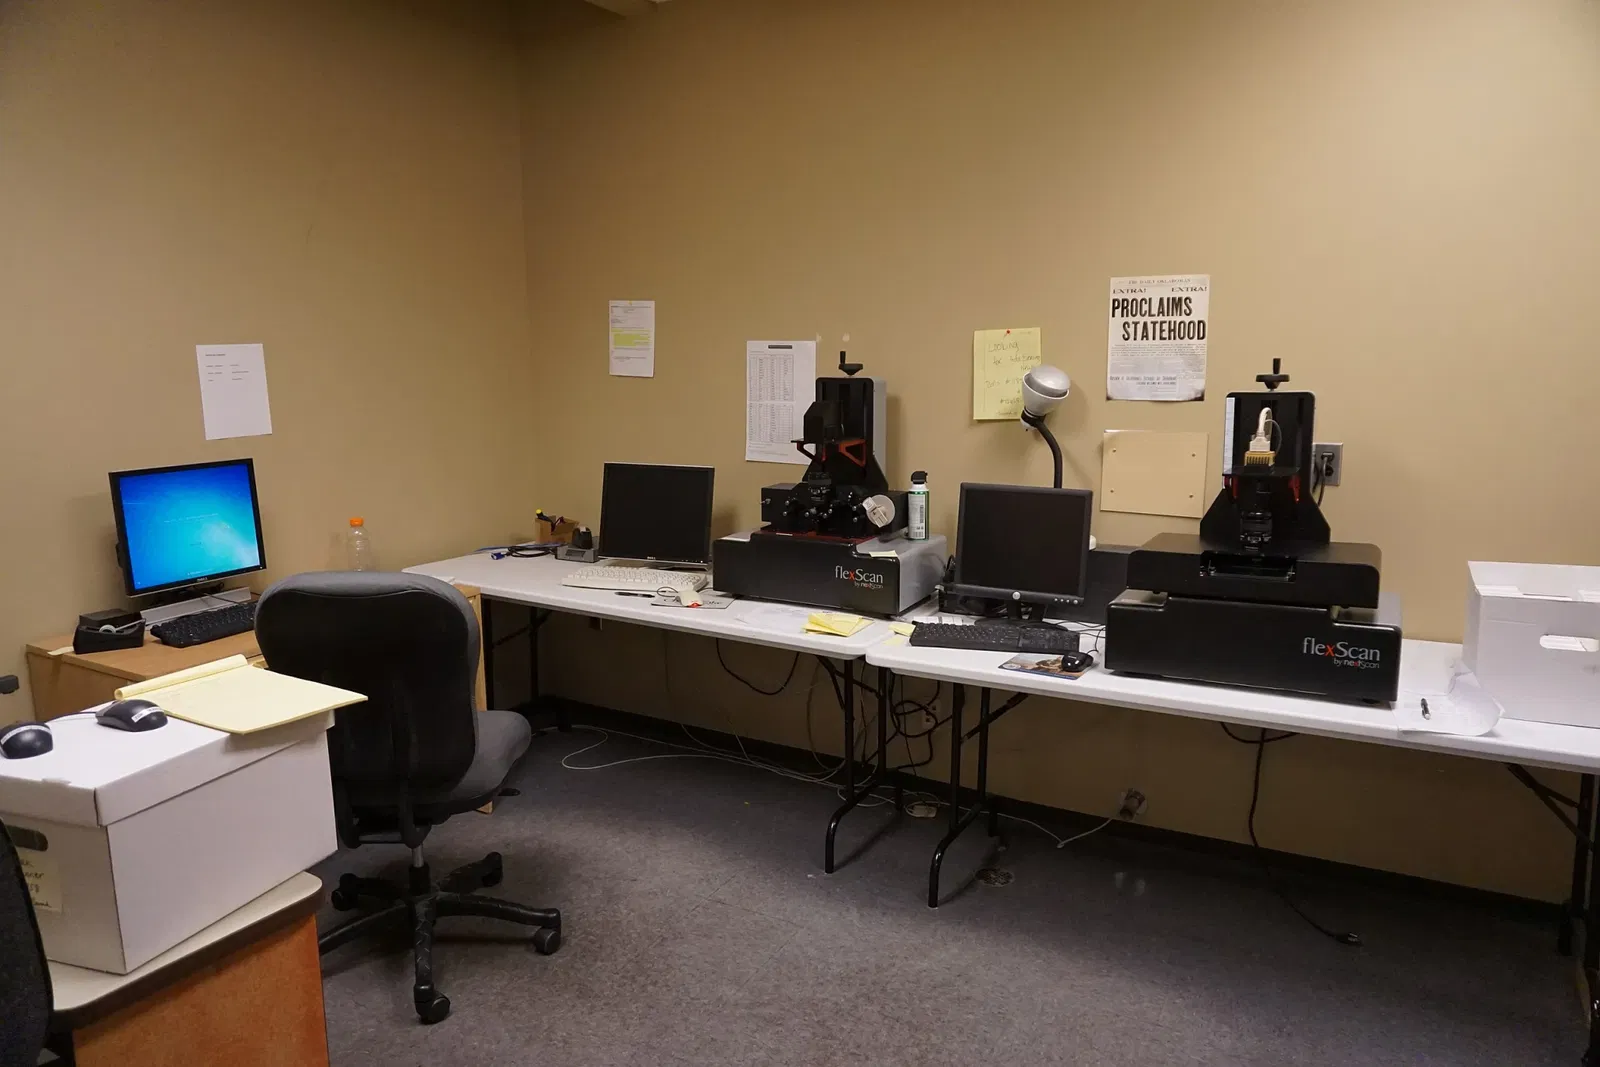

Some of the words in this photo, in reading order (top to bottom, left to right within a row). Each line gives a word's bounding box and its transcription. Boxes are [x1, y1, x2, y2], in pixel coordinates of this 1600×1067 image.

[1111, 296, 1193, 318] PROCLAIMS
[1122, 320, 1206, 341] STATEHOOD
[834, 565, 884, 584] flexScan
[1302, 637, 1381, 661] flexScan
[1333, 658, 1342, 667] by
